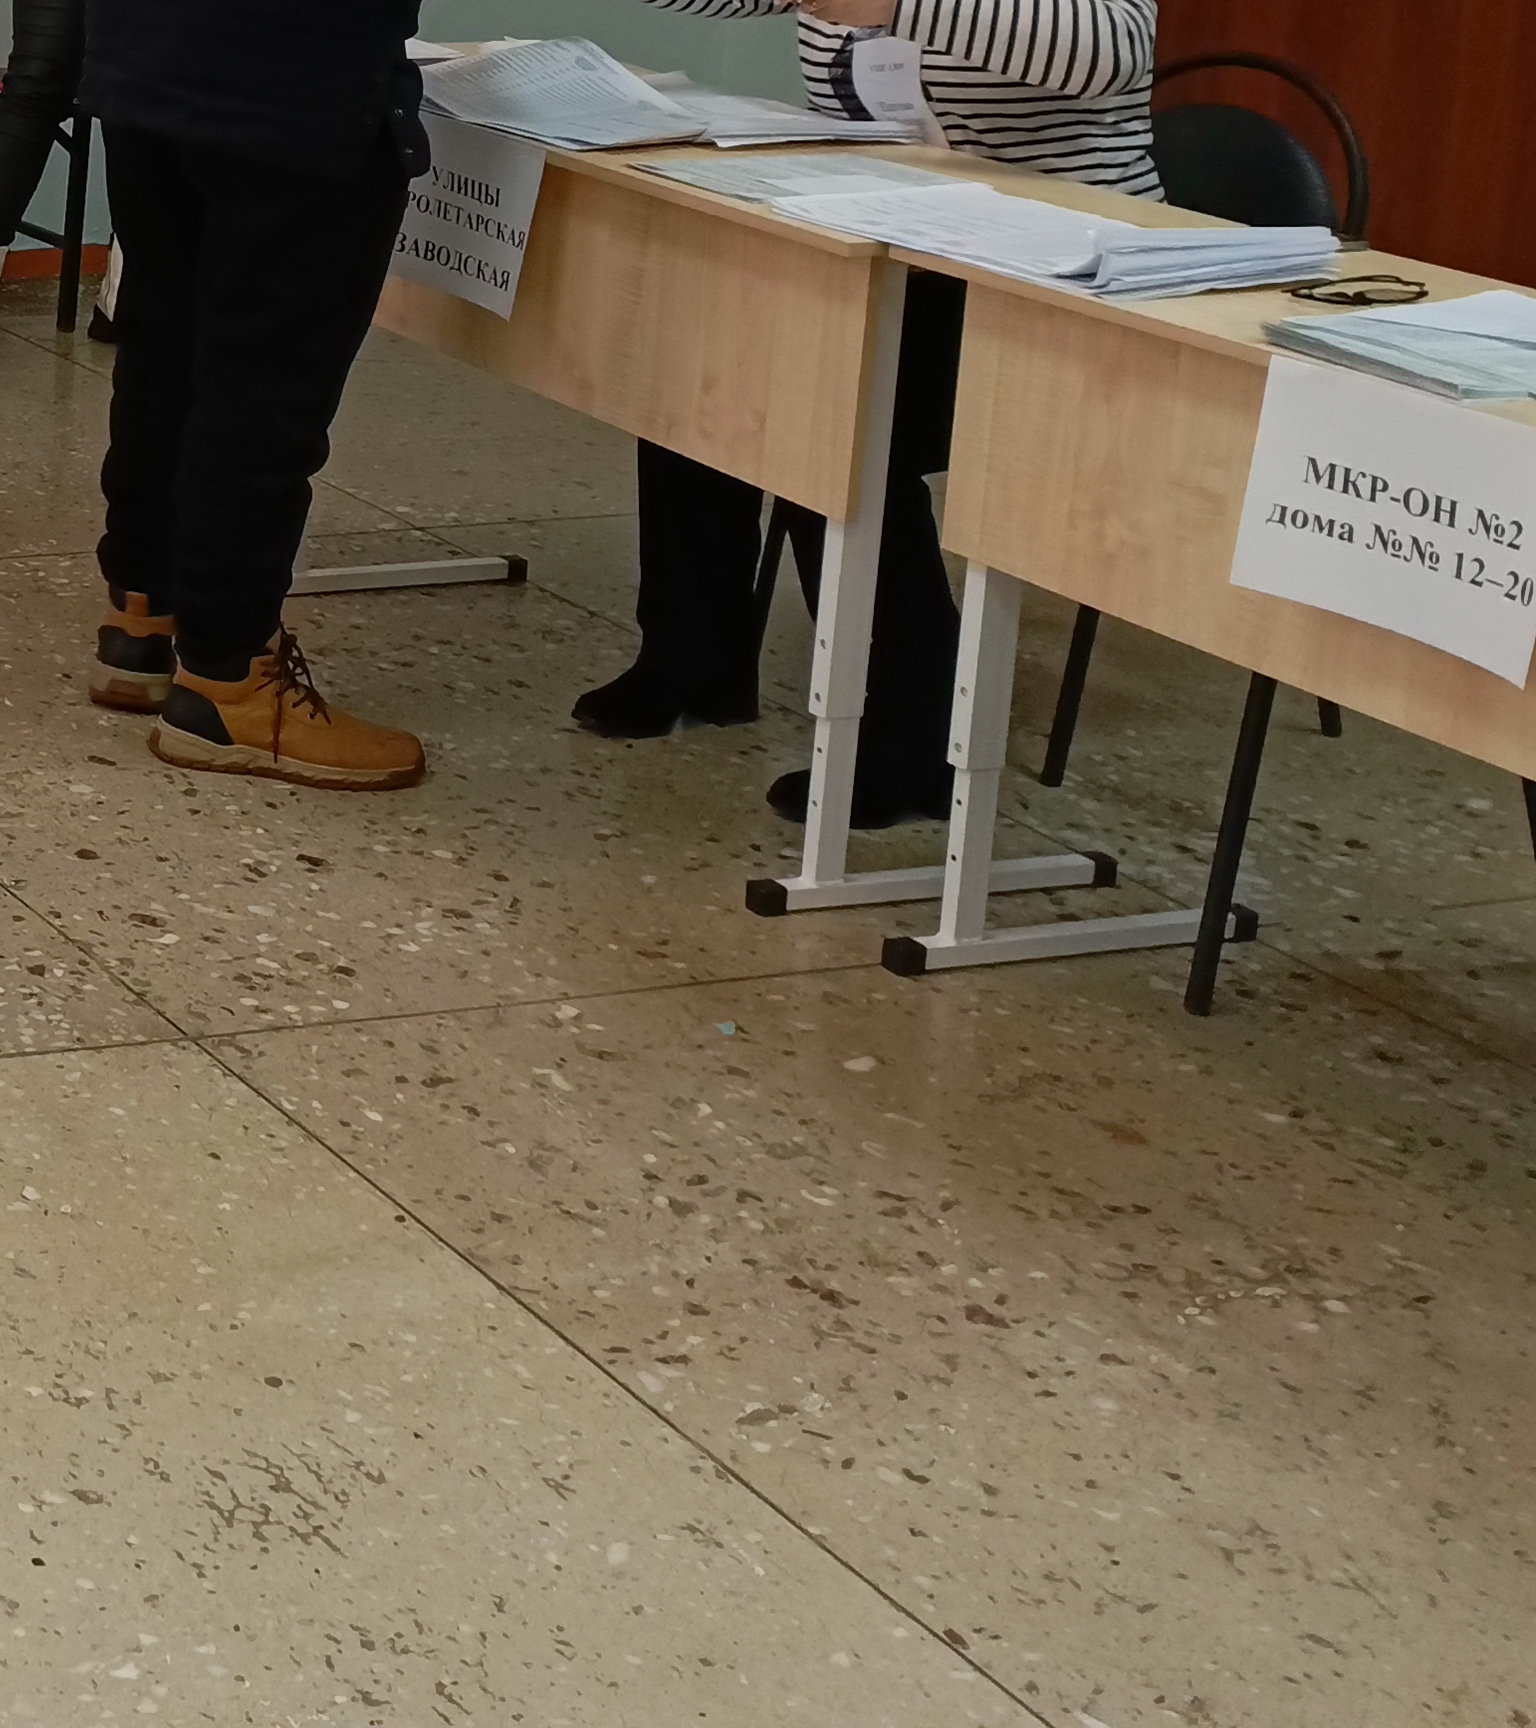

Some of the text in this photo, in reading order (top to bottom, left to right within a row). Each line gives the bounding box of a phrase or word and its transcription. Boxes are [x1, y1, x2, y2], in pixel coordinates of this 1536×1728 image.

[432, 166, 501, 207] УЛИЦЫ
[408, 190, 526, 250] РОЛЕТАРСКАЯ
[394, 232, 511, 292] ЗАВОДСКАЯ
[1302, 454, 1524, 551] МКР-ОН №2
[1265, 502, 1356, 545] дома
[1365, 522, 1441, 572] №№
